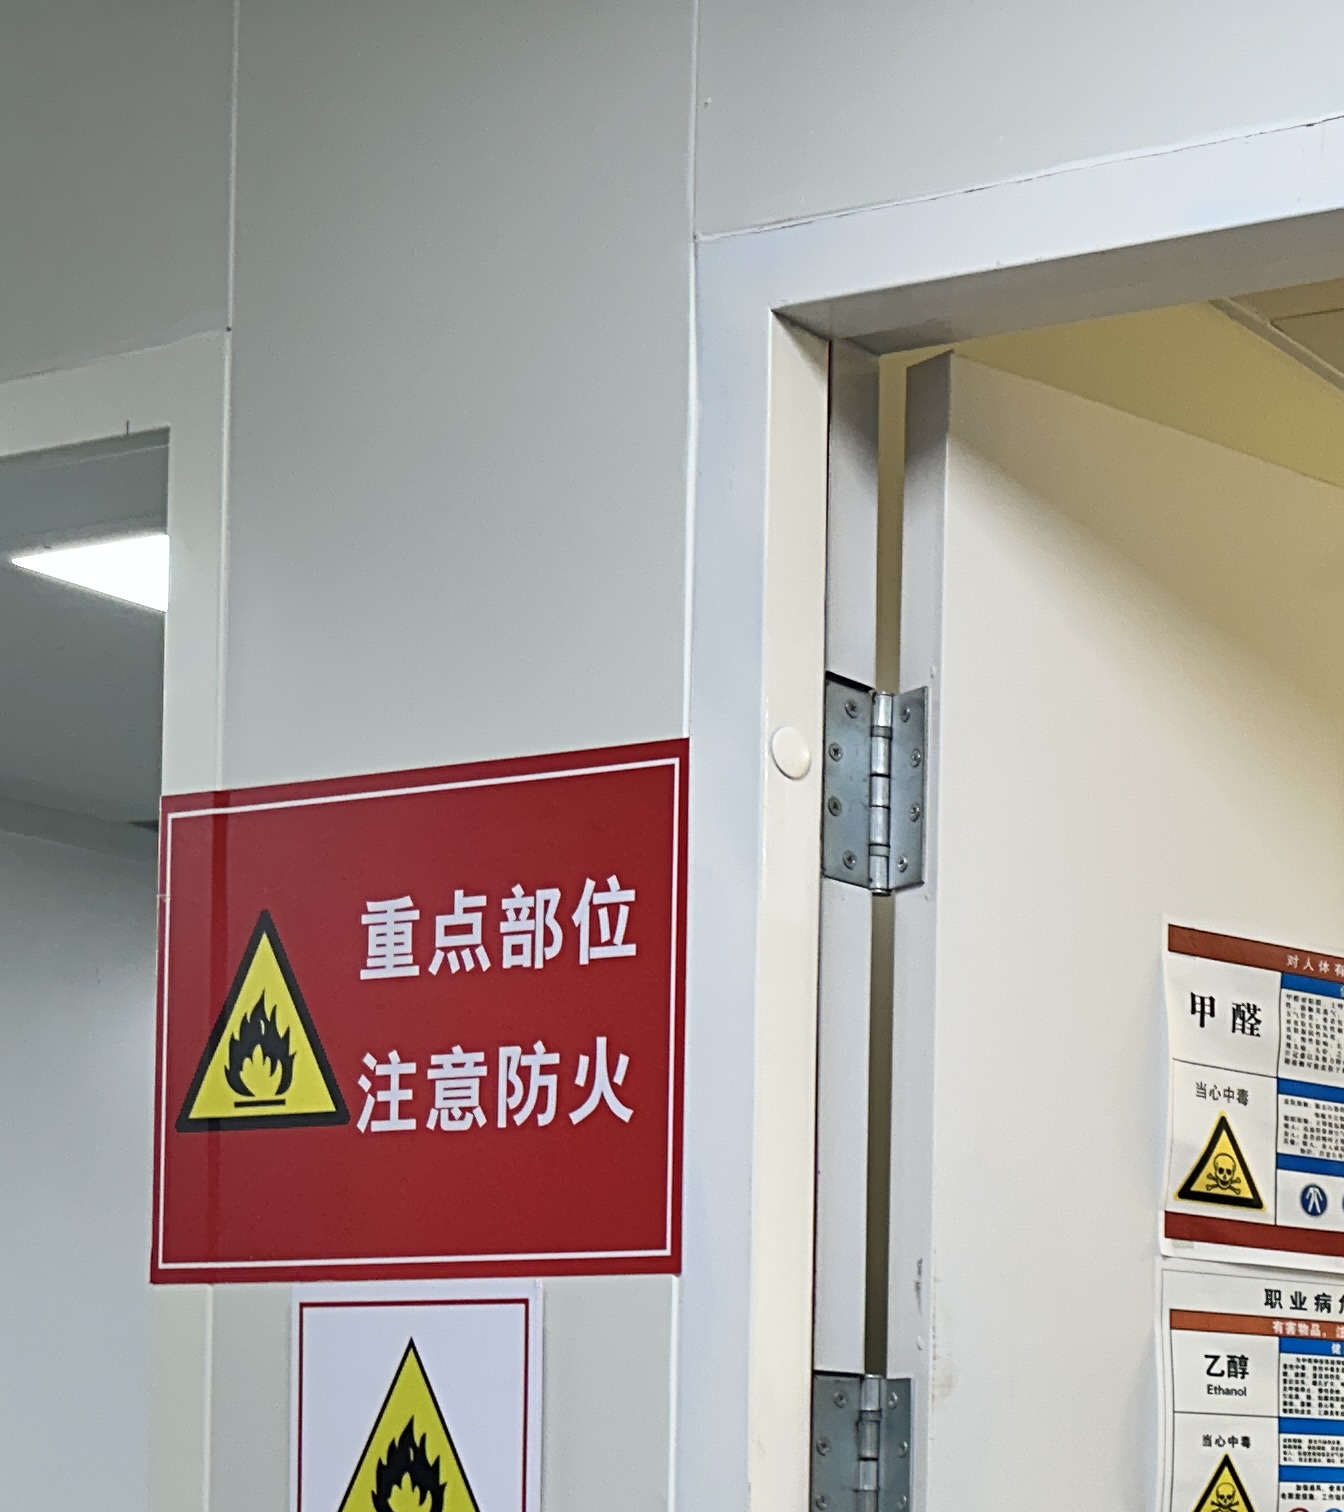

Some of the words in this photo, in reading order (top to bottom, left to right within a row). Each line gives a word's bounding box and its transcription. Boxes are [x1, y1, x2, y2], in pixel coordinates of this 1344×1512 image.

[360, 875, 637, 980] 重点部位
[1189, 991, 1264, 1039] 甲醛
[356, 1036, 634, 1134] 注意防火
[1195, 1080, 1250, 1107] 当心中毒
[1204, 1353, 1250, 1381] 乙醇
[1206, 1384, 1248, 1398] Ethanol
[1202, 1434, 1251, 1450] 当心中毒
